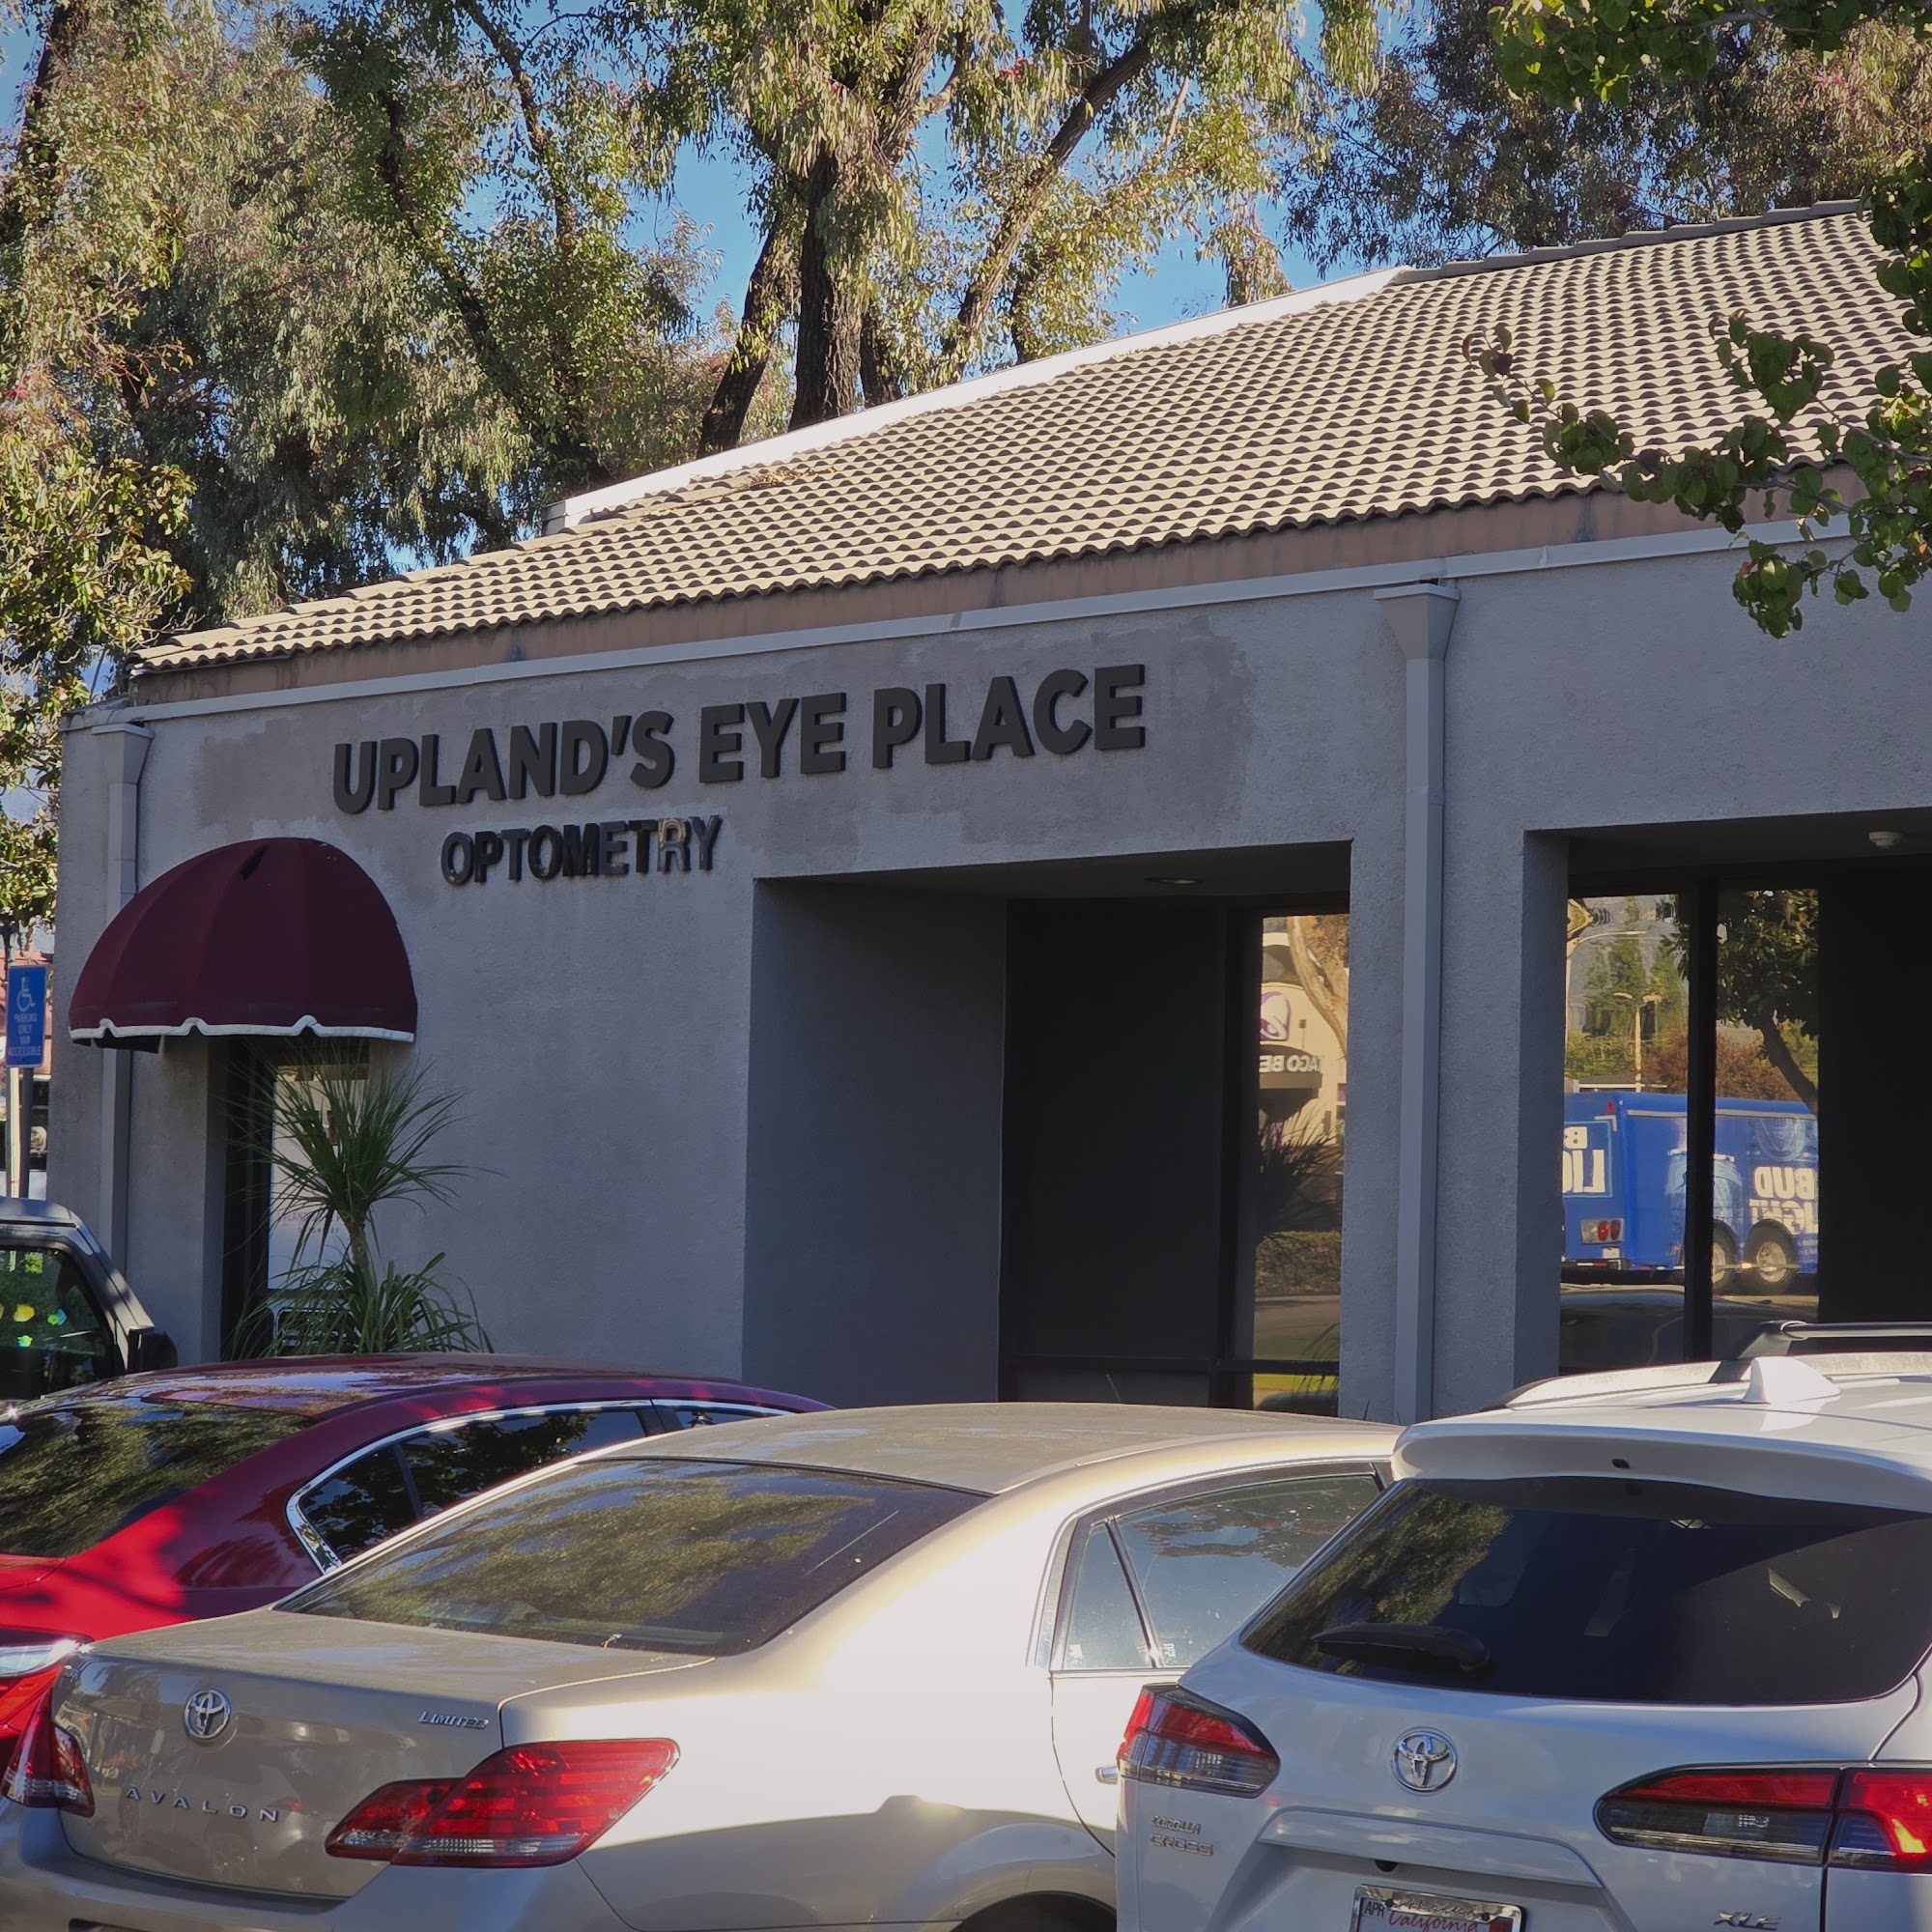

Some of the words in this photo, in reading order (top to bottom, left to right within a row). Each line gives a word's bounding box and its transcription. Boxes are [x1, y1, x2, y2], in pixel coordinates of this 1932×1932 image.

[333, 710, 674, 814] UPLAND'S
[699, 693, 846, 783] EYE
[872, 664, 1146, 768] PLACE
[440, 814, 723, 887] OPTOMETRY
[14, 1012, 38, 1023] PARKING
[126, 1786, 280, 1823] AVALON
[1151, 1833, 1214, 1857] CROSS
[1364, 1900, 1385, 1918] APR
[1387, 1908, 1480, 1932] California
[1714, 1910, 1781, 1931] XLE
